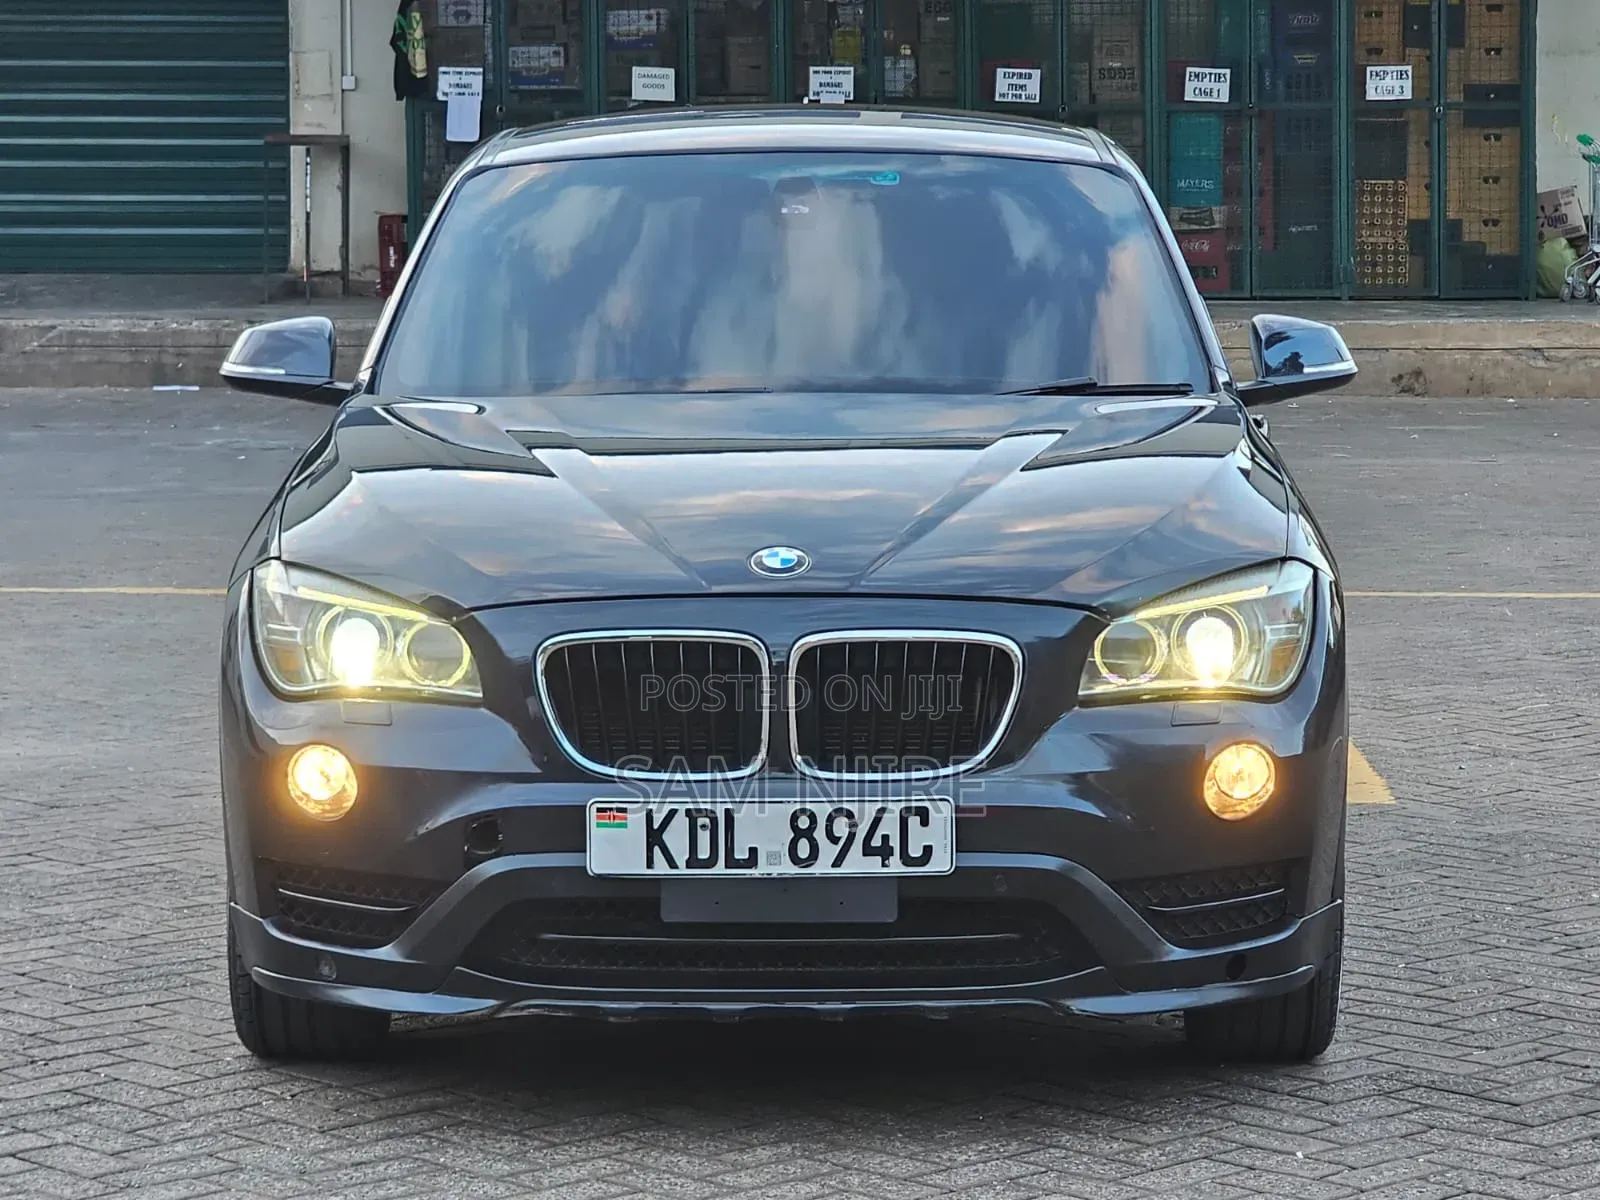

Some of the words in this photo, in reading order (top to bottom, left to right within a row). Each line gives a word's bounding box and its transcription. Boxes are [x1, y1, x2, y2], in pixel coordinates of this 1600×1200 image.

[637, 72, 670, 80] DAMAGED
[1003, 71, 1033, 80] EXPIRED
[1188, 71, 1227, 83] EMPTIES
[1369, 70, 1410, 81] EMPTIES
[642, 82, 666, 90] GOODS
[1007, 83, 1028, 92] ITEMS
[1374, 84, 1395, 95] CAGE
[1398, 84, 1404, 95] 3
[1011, 92, 1023, 100] FOR
[1024, 93, 1037, 101] SALE
[1193, 86, 1214, 97] CAGE
[1216, 87, 1221, 99] 1
[1176, 178, 1215, 189] MAYERS
[645, 807, 759, 869] KDL
[787, 806, 934, 869] 894C
